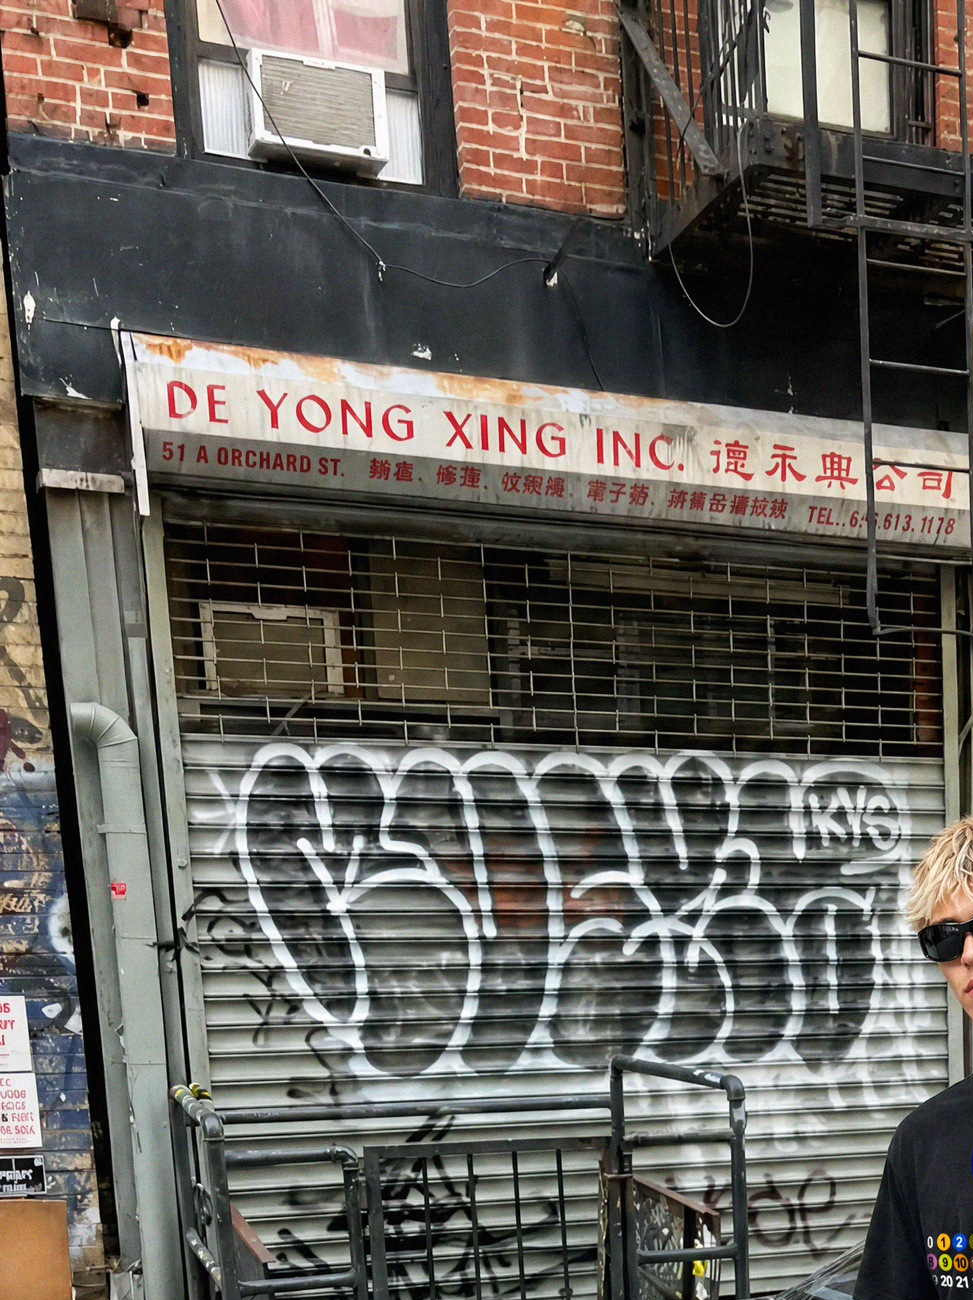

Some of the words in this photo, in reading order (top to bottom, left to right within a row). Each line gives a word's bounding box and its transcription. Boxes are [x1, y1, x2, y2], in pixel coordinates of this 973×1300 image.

[166, 380, 229, 424] DE
[256, 388, 415, 441] YONG
[443, 411, 567, 458] XING
[596, 428, 686, 471] INC.
[161, 441, 186, 462] 51
[196, 445, 209, 464] A
[216, 446, 312, 474] ORCHARD
[318, 457, 345, 477] ST.
[927, 1235, 934, 1249] 0
[956, 1236, 963, 1248] 2
[927, 1256, 935, 1268] 8
[942, 1257, 949, 1268] 9
[954, 1257, 967, 1269] 10
[940, 1274, 954, 1288] 20
[955, 1275, 969, 1289] 21
